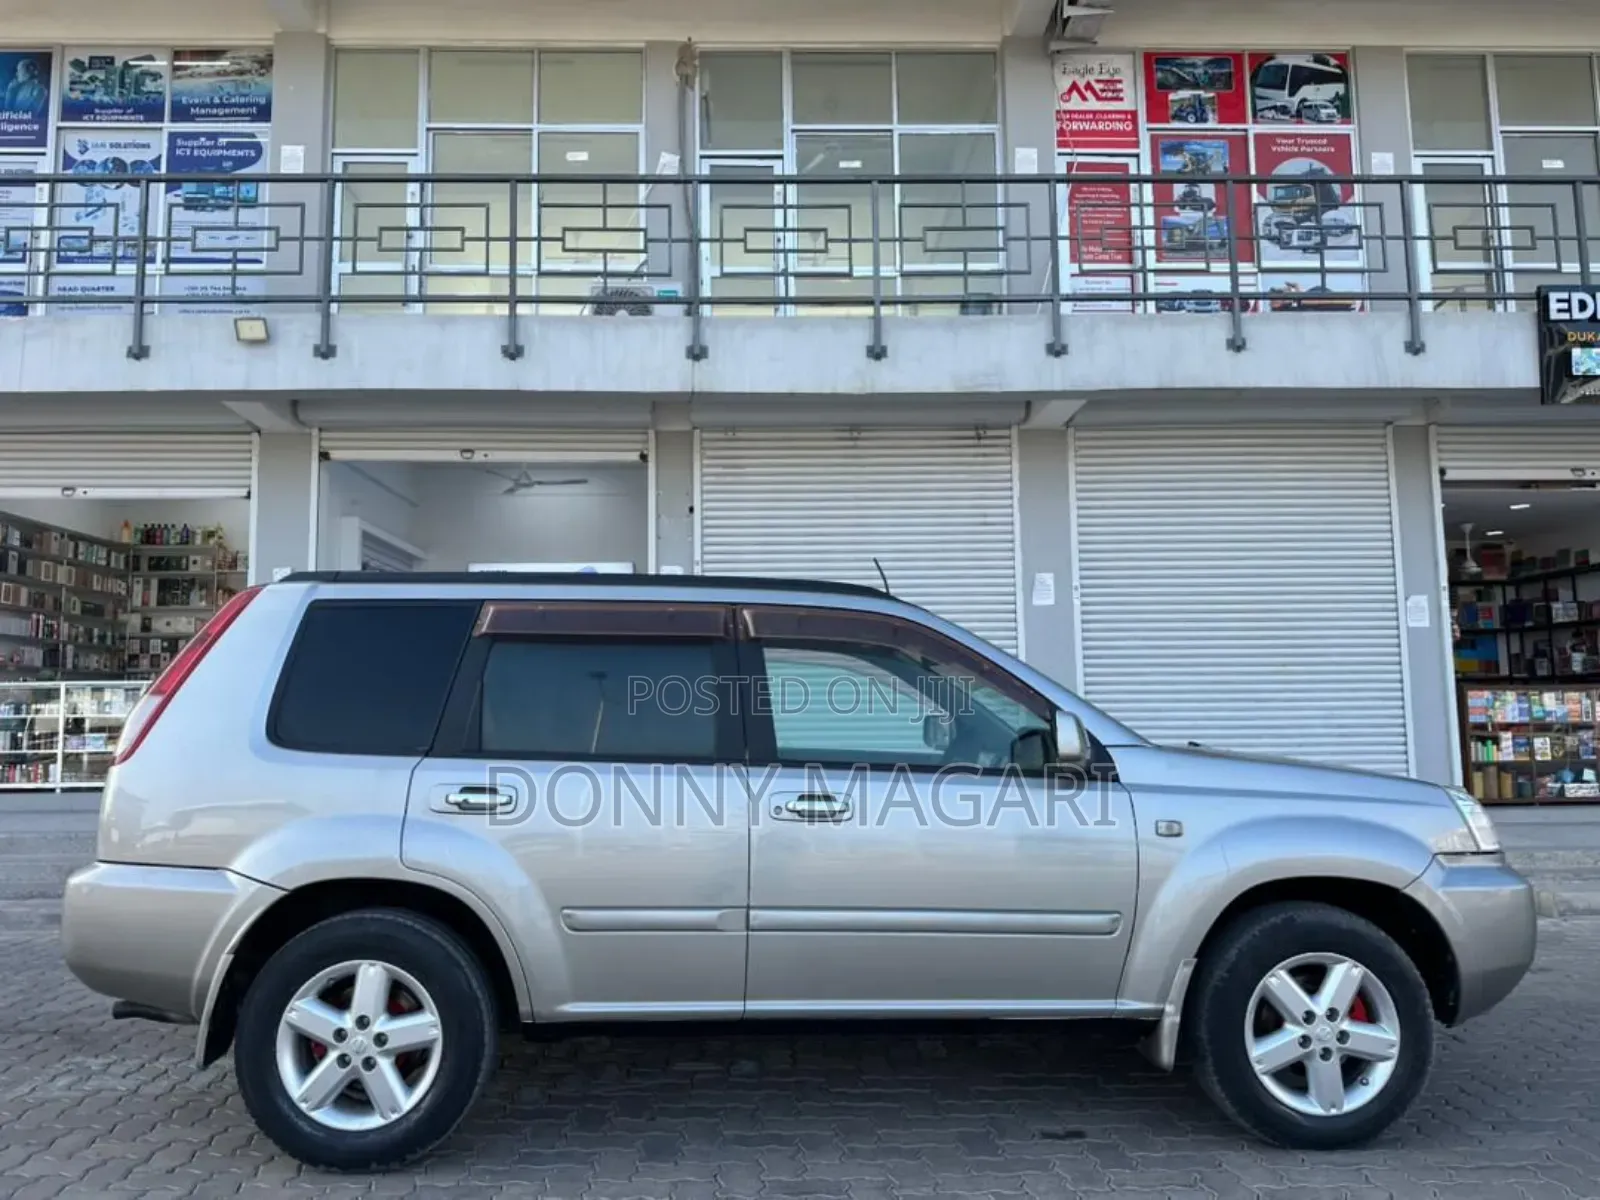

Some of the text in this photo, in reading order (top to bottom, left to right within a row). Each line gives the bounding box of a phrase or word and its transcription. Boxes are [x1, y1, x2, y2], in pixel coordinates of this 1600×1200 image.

[190, 106, 257, 116] Management
[1056, 121, 1133, 131] FORWARDING
[175, 148, 256, 158] ICT EQUIPMENTS
